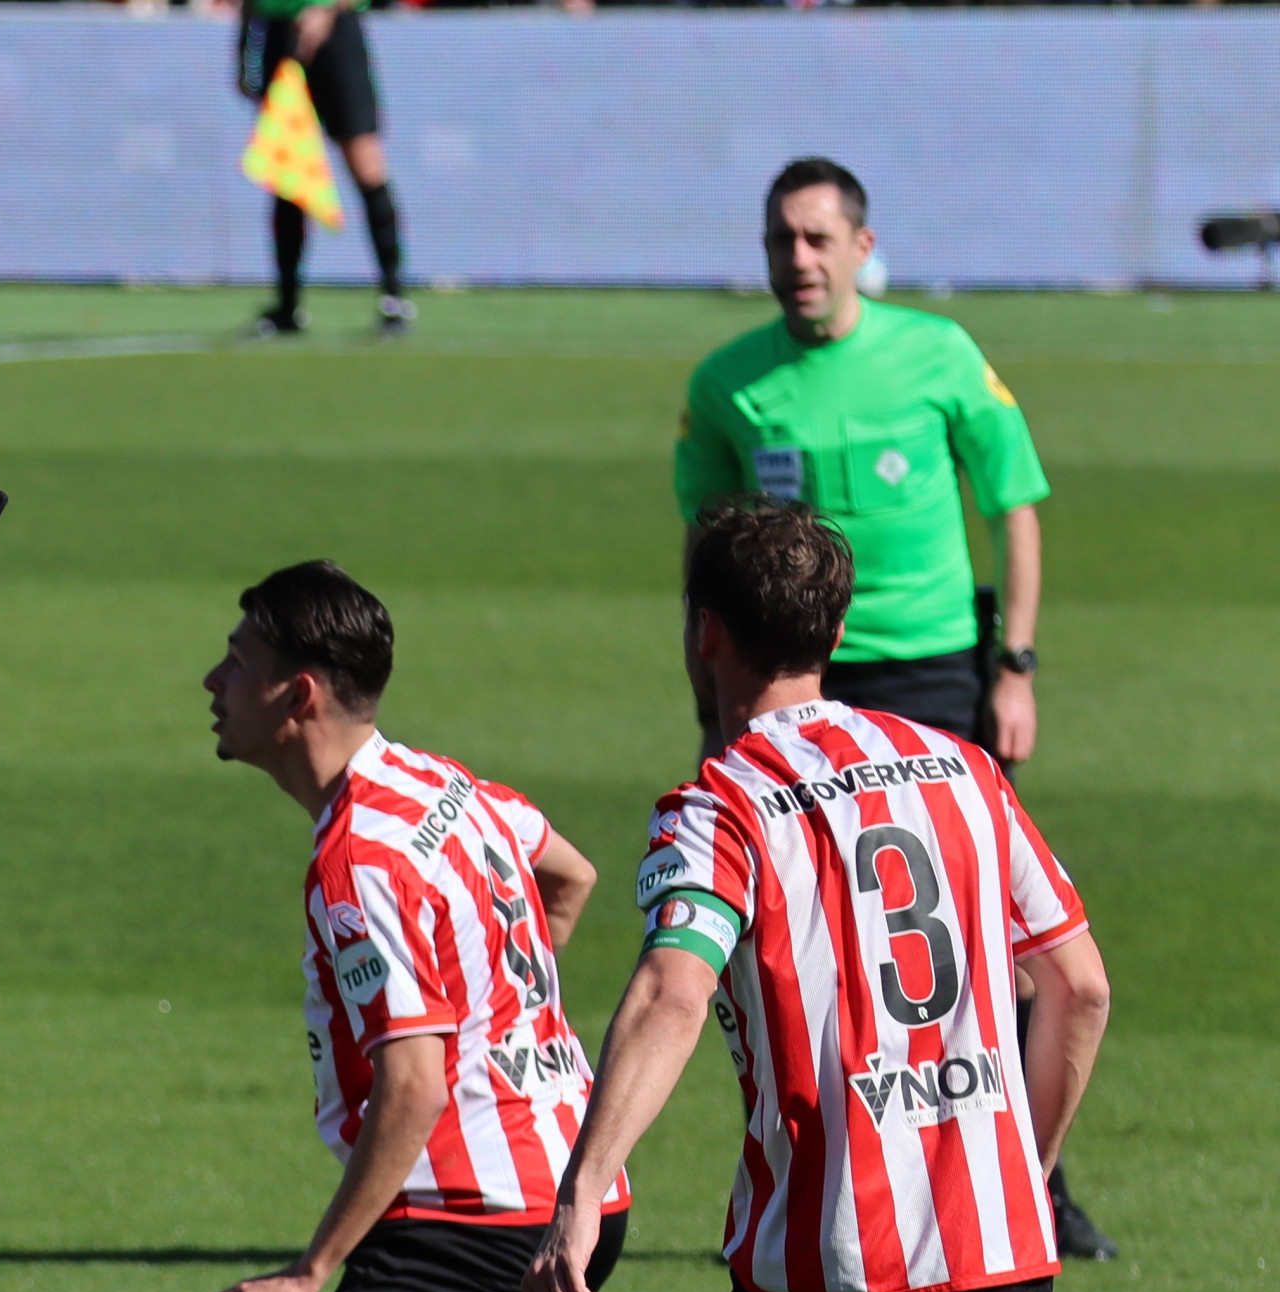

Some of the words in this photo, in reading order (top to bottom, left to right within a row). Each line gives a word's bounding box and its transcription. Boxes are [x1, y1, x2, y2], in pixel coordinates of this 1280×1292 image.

[761, 756, 967, 818] NICOVERKEN
[639, 863, 679, 897] TOTO
[855, 826, 958, 1027] 3
[342, 956, 383, 992] TOTO
